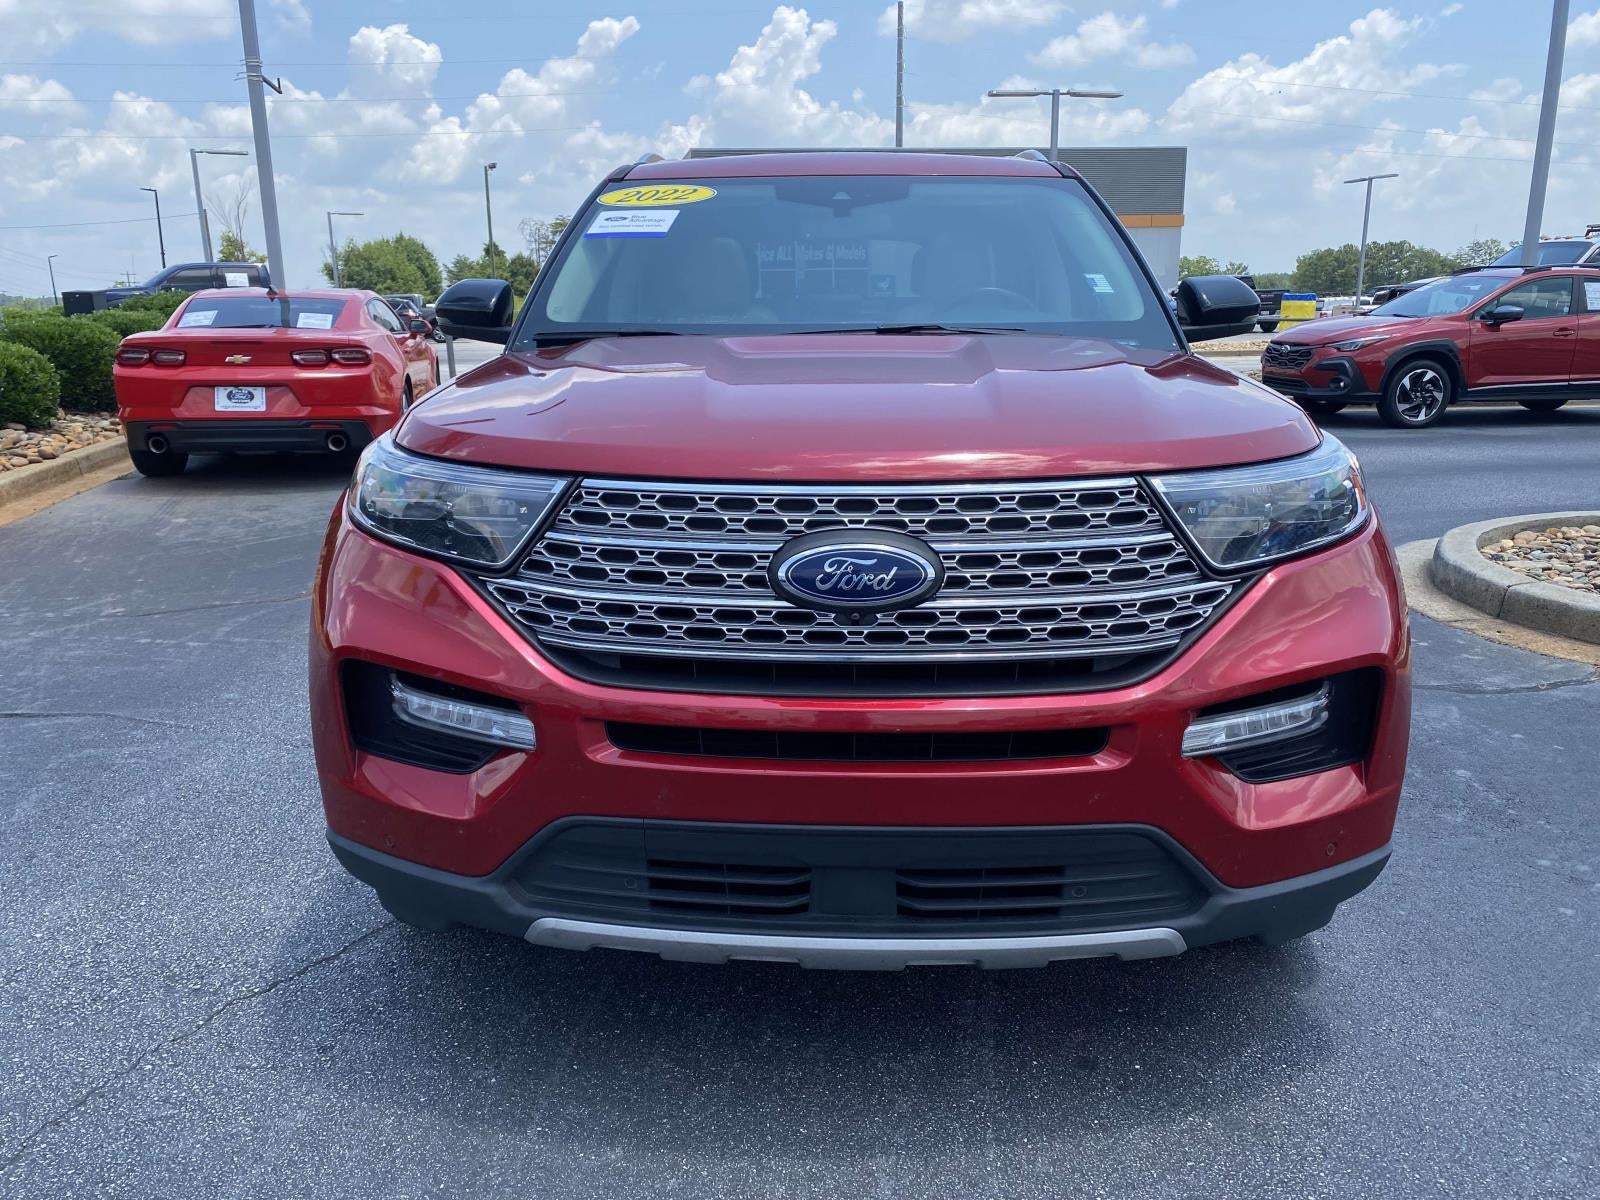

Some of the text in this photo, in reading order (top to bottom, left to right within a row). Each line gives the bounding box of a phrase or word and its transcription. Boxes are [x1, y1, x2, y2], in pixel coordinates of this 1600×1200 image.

[616, 188, 698, 202] 2022
[776, 245, 793, 261] ALL
[815, 557, 898, 591] Ford
